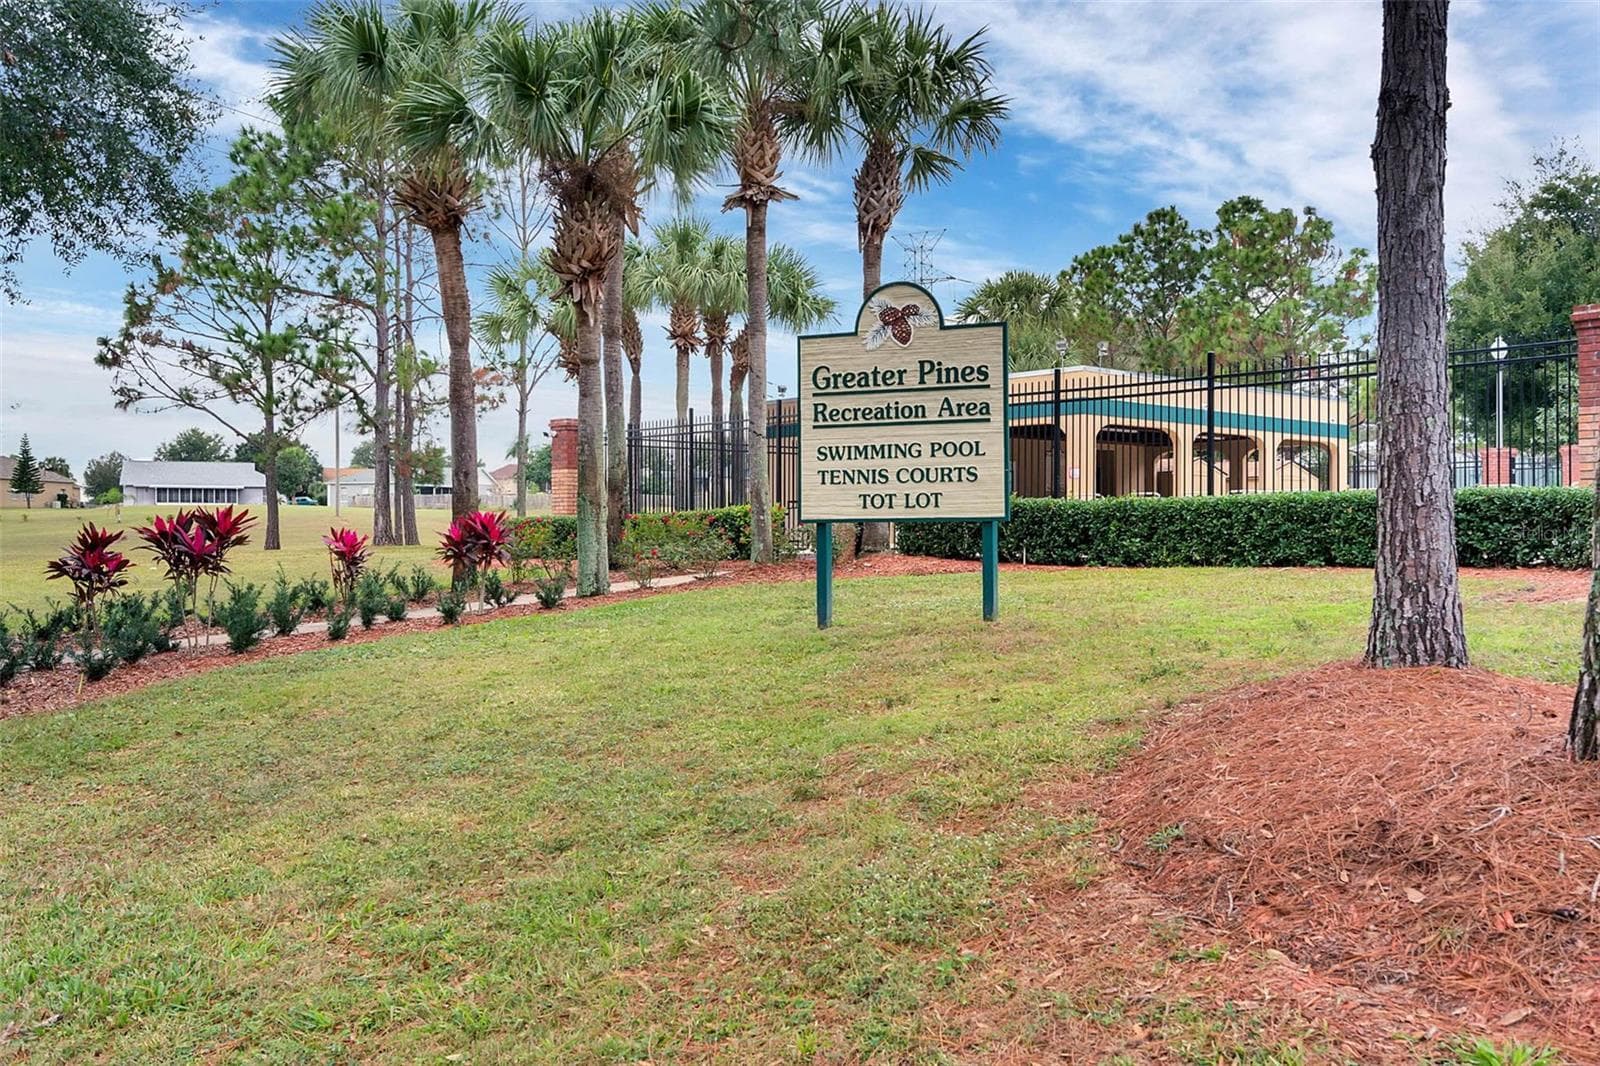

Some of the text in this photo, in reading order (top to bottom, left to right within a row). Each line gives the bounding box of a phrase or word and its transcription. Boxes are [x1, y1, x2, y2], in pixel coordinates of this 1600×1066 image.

[812, 359, 989, 390] Greater Pines
[813, 397, 991, 423] Recreation Area
[816, 440, 986, 462] SWIMMING POOL
[817, 466, 978, 485] TENNIS COURTS
[858, 492, 943, 509] TOT LOT
